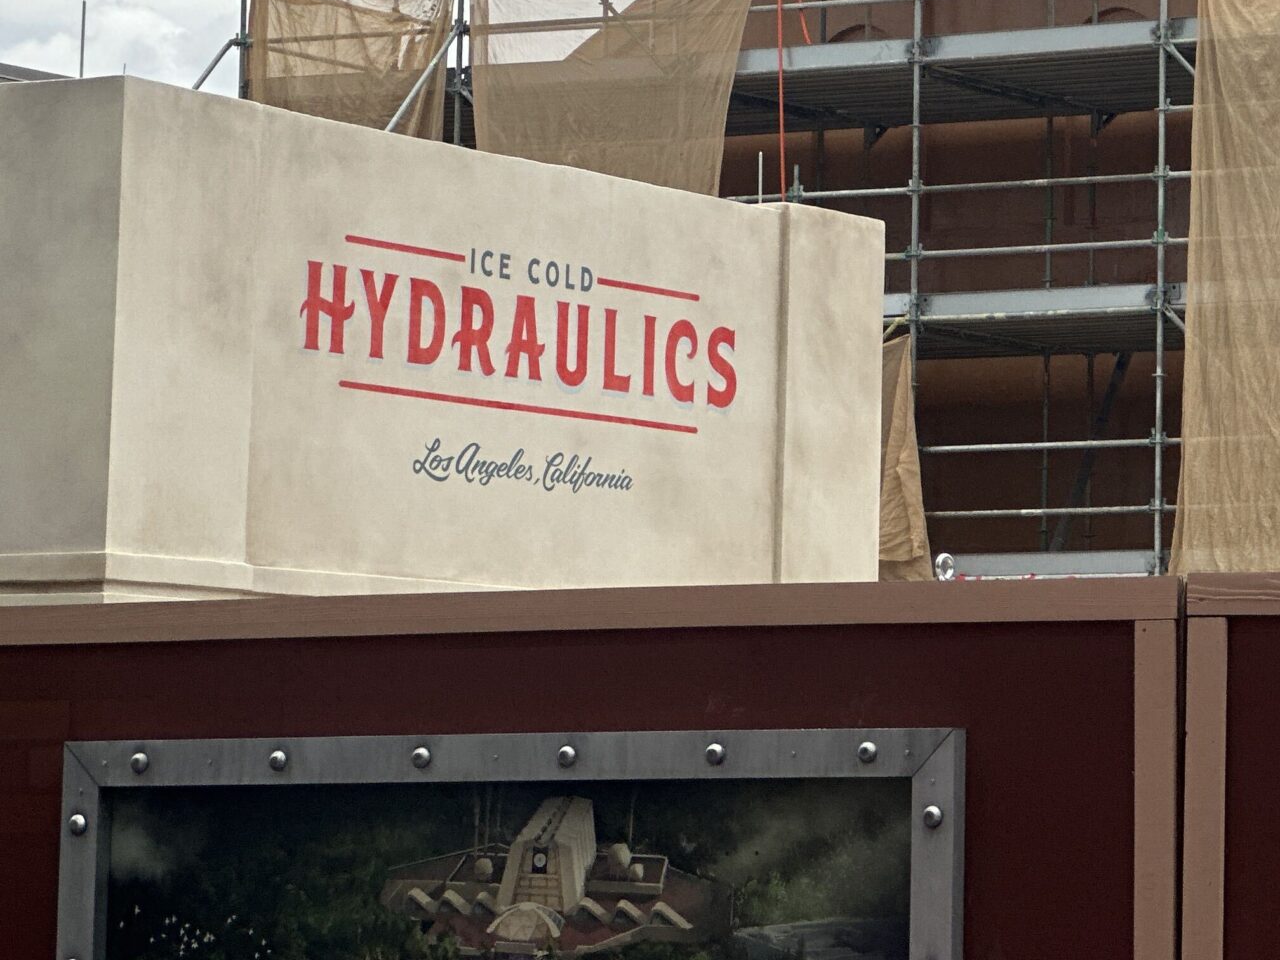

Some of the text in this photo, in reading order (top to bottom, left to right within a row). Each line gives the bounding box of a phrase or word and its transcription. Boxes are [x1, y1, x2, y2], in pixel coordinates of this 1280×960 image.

[470, 247, 593, 292] ICE COLD
[300, 260, 737, 408] HYDRAULICS
[413, 438, 634, 494] Los Angeles, California
